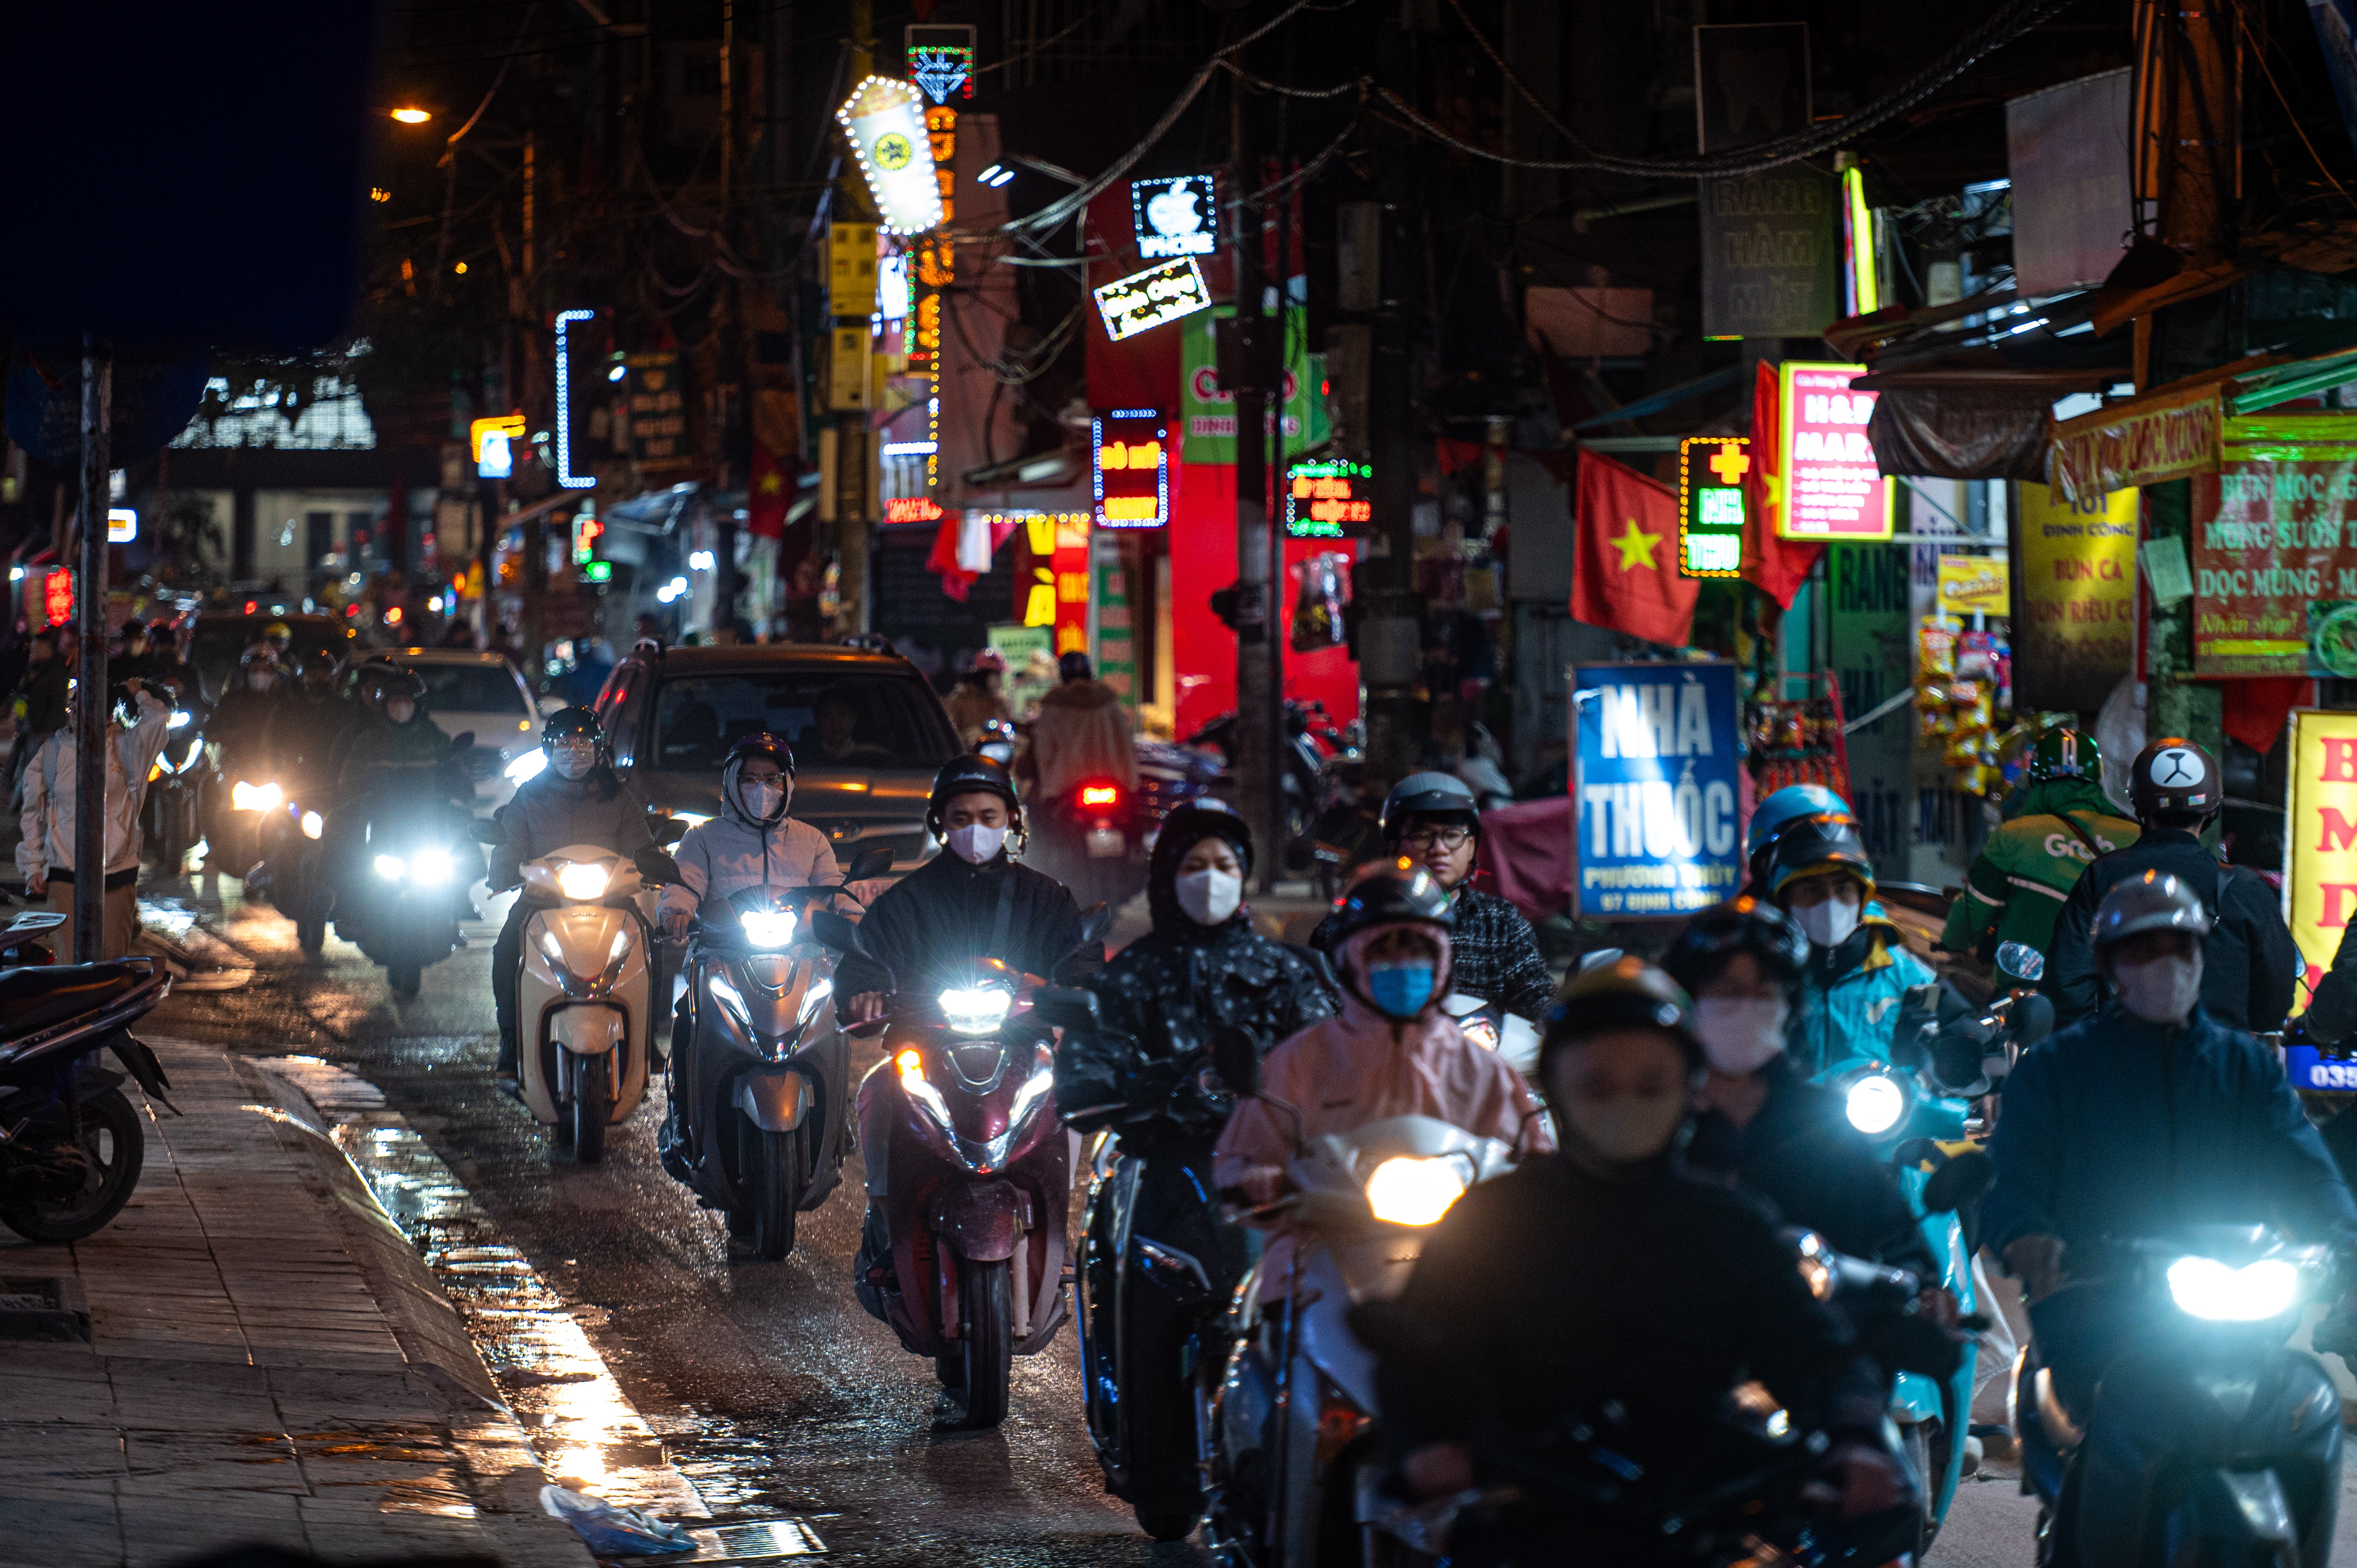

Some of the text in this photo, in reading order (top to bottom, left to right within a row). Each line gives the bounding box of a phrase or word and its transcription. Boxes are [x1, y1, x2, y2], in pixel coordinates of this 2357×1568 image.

[1794, 432, 1876, 462] MAR
[2220, 466, 2268, 502] BÚN
[1600, 670, 1714, 758] NHÀ
[1584, 758, 1734, 858] THUỐC
